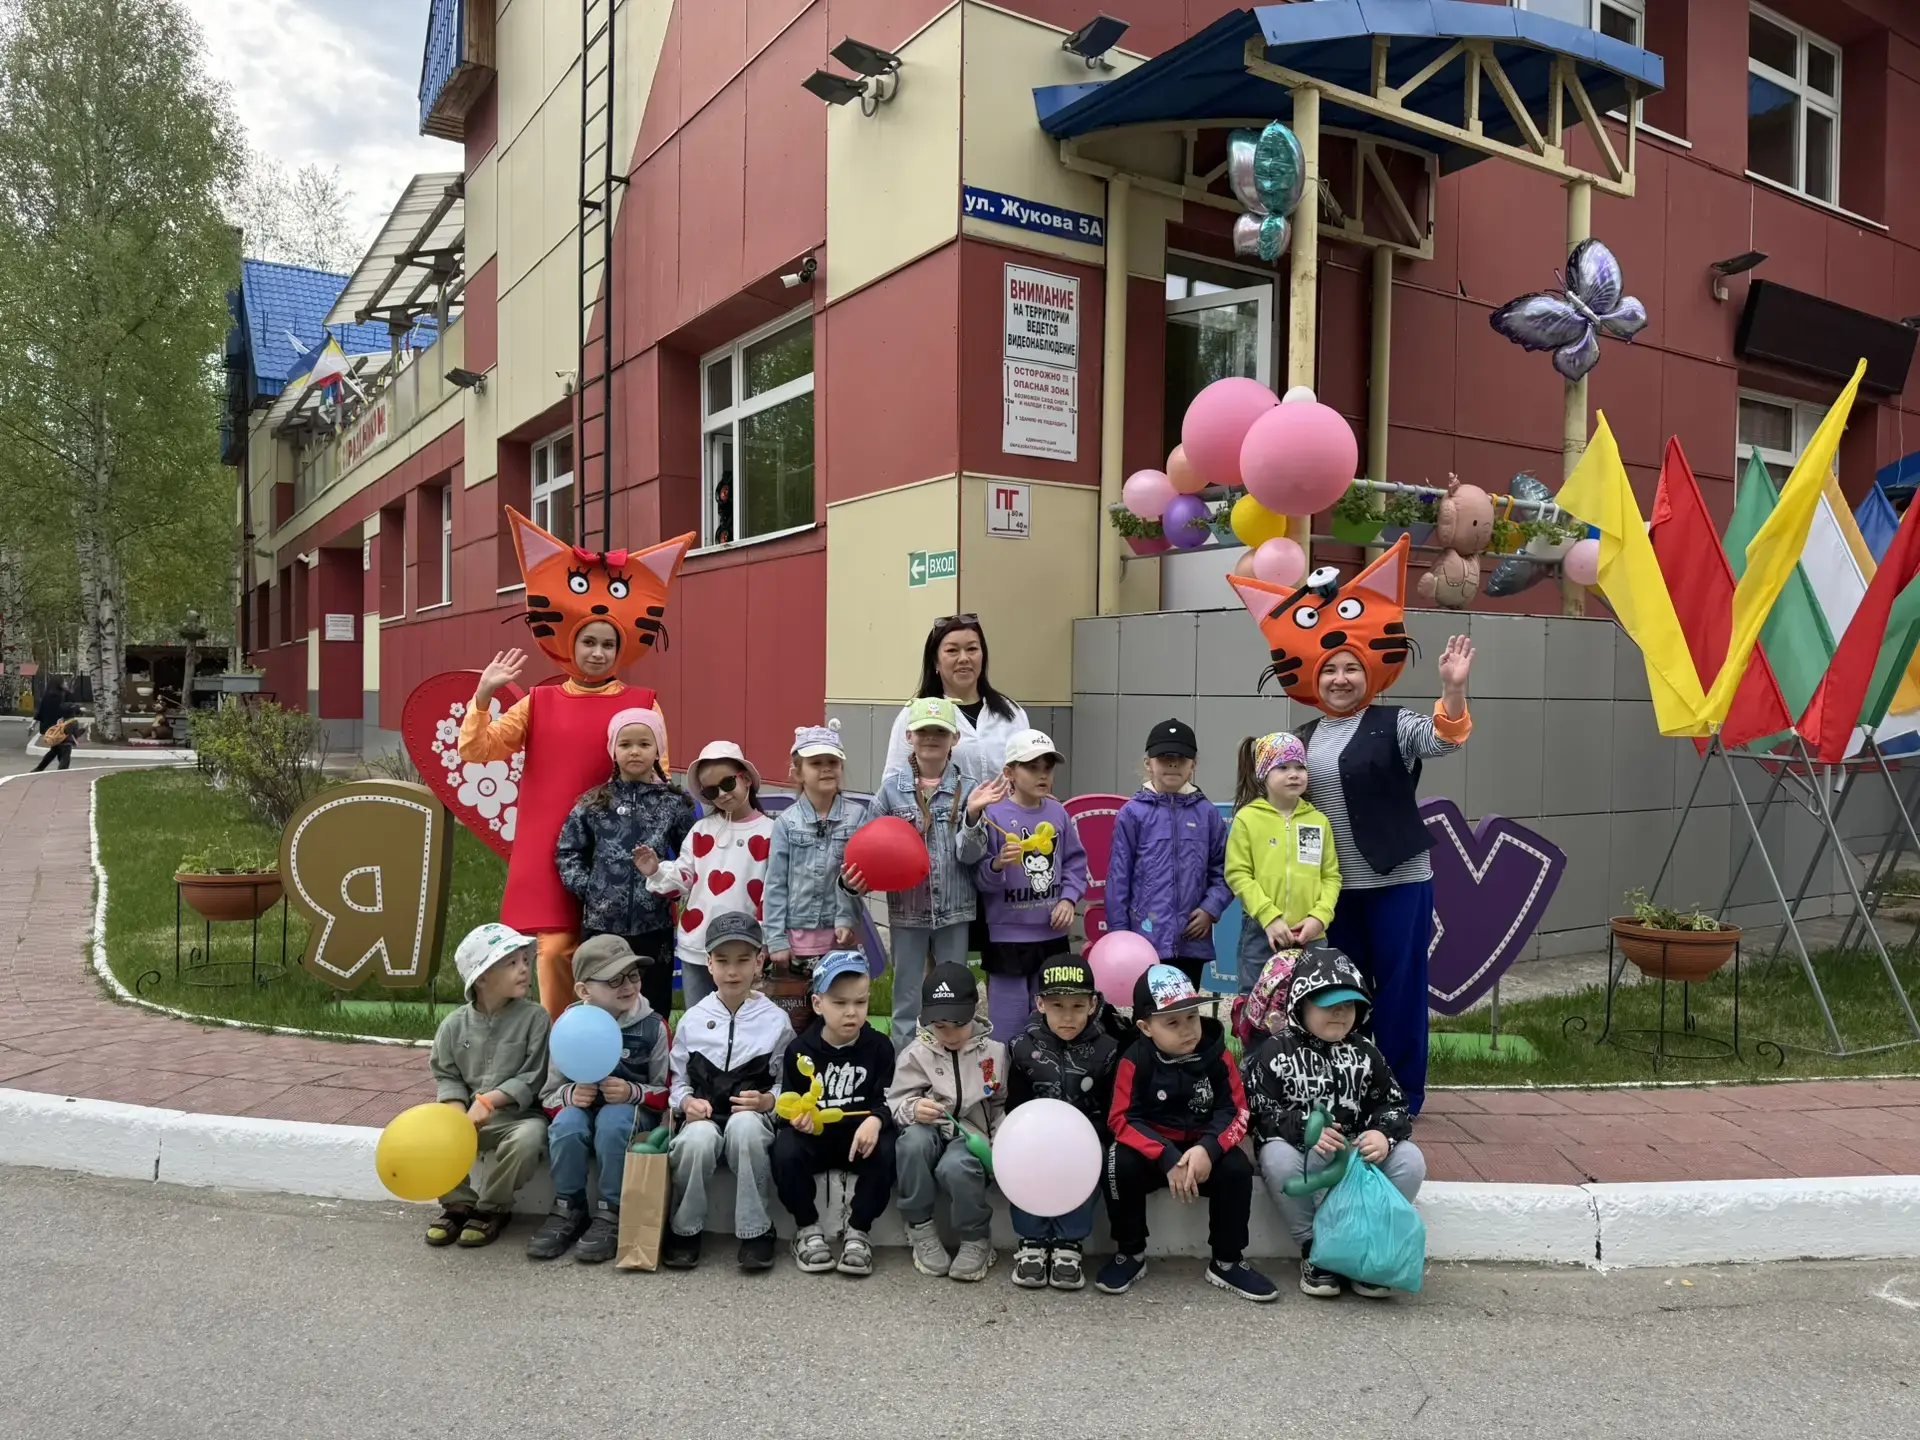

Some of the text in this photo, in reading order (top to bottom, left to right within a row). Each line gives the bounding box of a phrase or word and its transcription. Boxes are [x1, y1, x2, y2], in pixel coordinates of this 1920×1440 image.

[964, 194, 1103, 237] ул. Жукова 5А
[1010, 279, 1074, 311] ВНИМАНИЕ
[1013, 303, 1070, 324] НА ТЕРРИТОРИИ
[1027, 320, 1058, 337] ВЕДЕТСЯ
[1007, 333, 1075, 356] ВИДЕОНАБЛЮДЕНИЕ
[1014, 366, 1061, 381] ОСТОРОЖНО
[1013, 380, 1070, 396] ОПАСНАЯ ЗОНА
[996, 488, 1019, 510] ПГ
[929, 556, 954, 574] ВХОД
[1003, 884, 1063, 903] KUROM
[1043, 966, 1084, 984] STRONG
[932, 991, 955, 999] adidas
